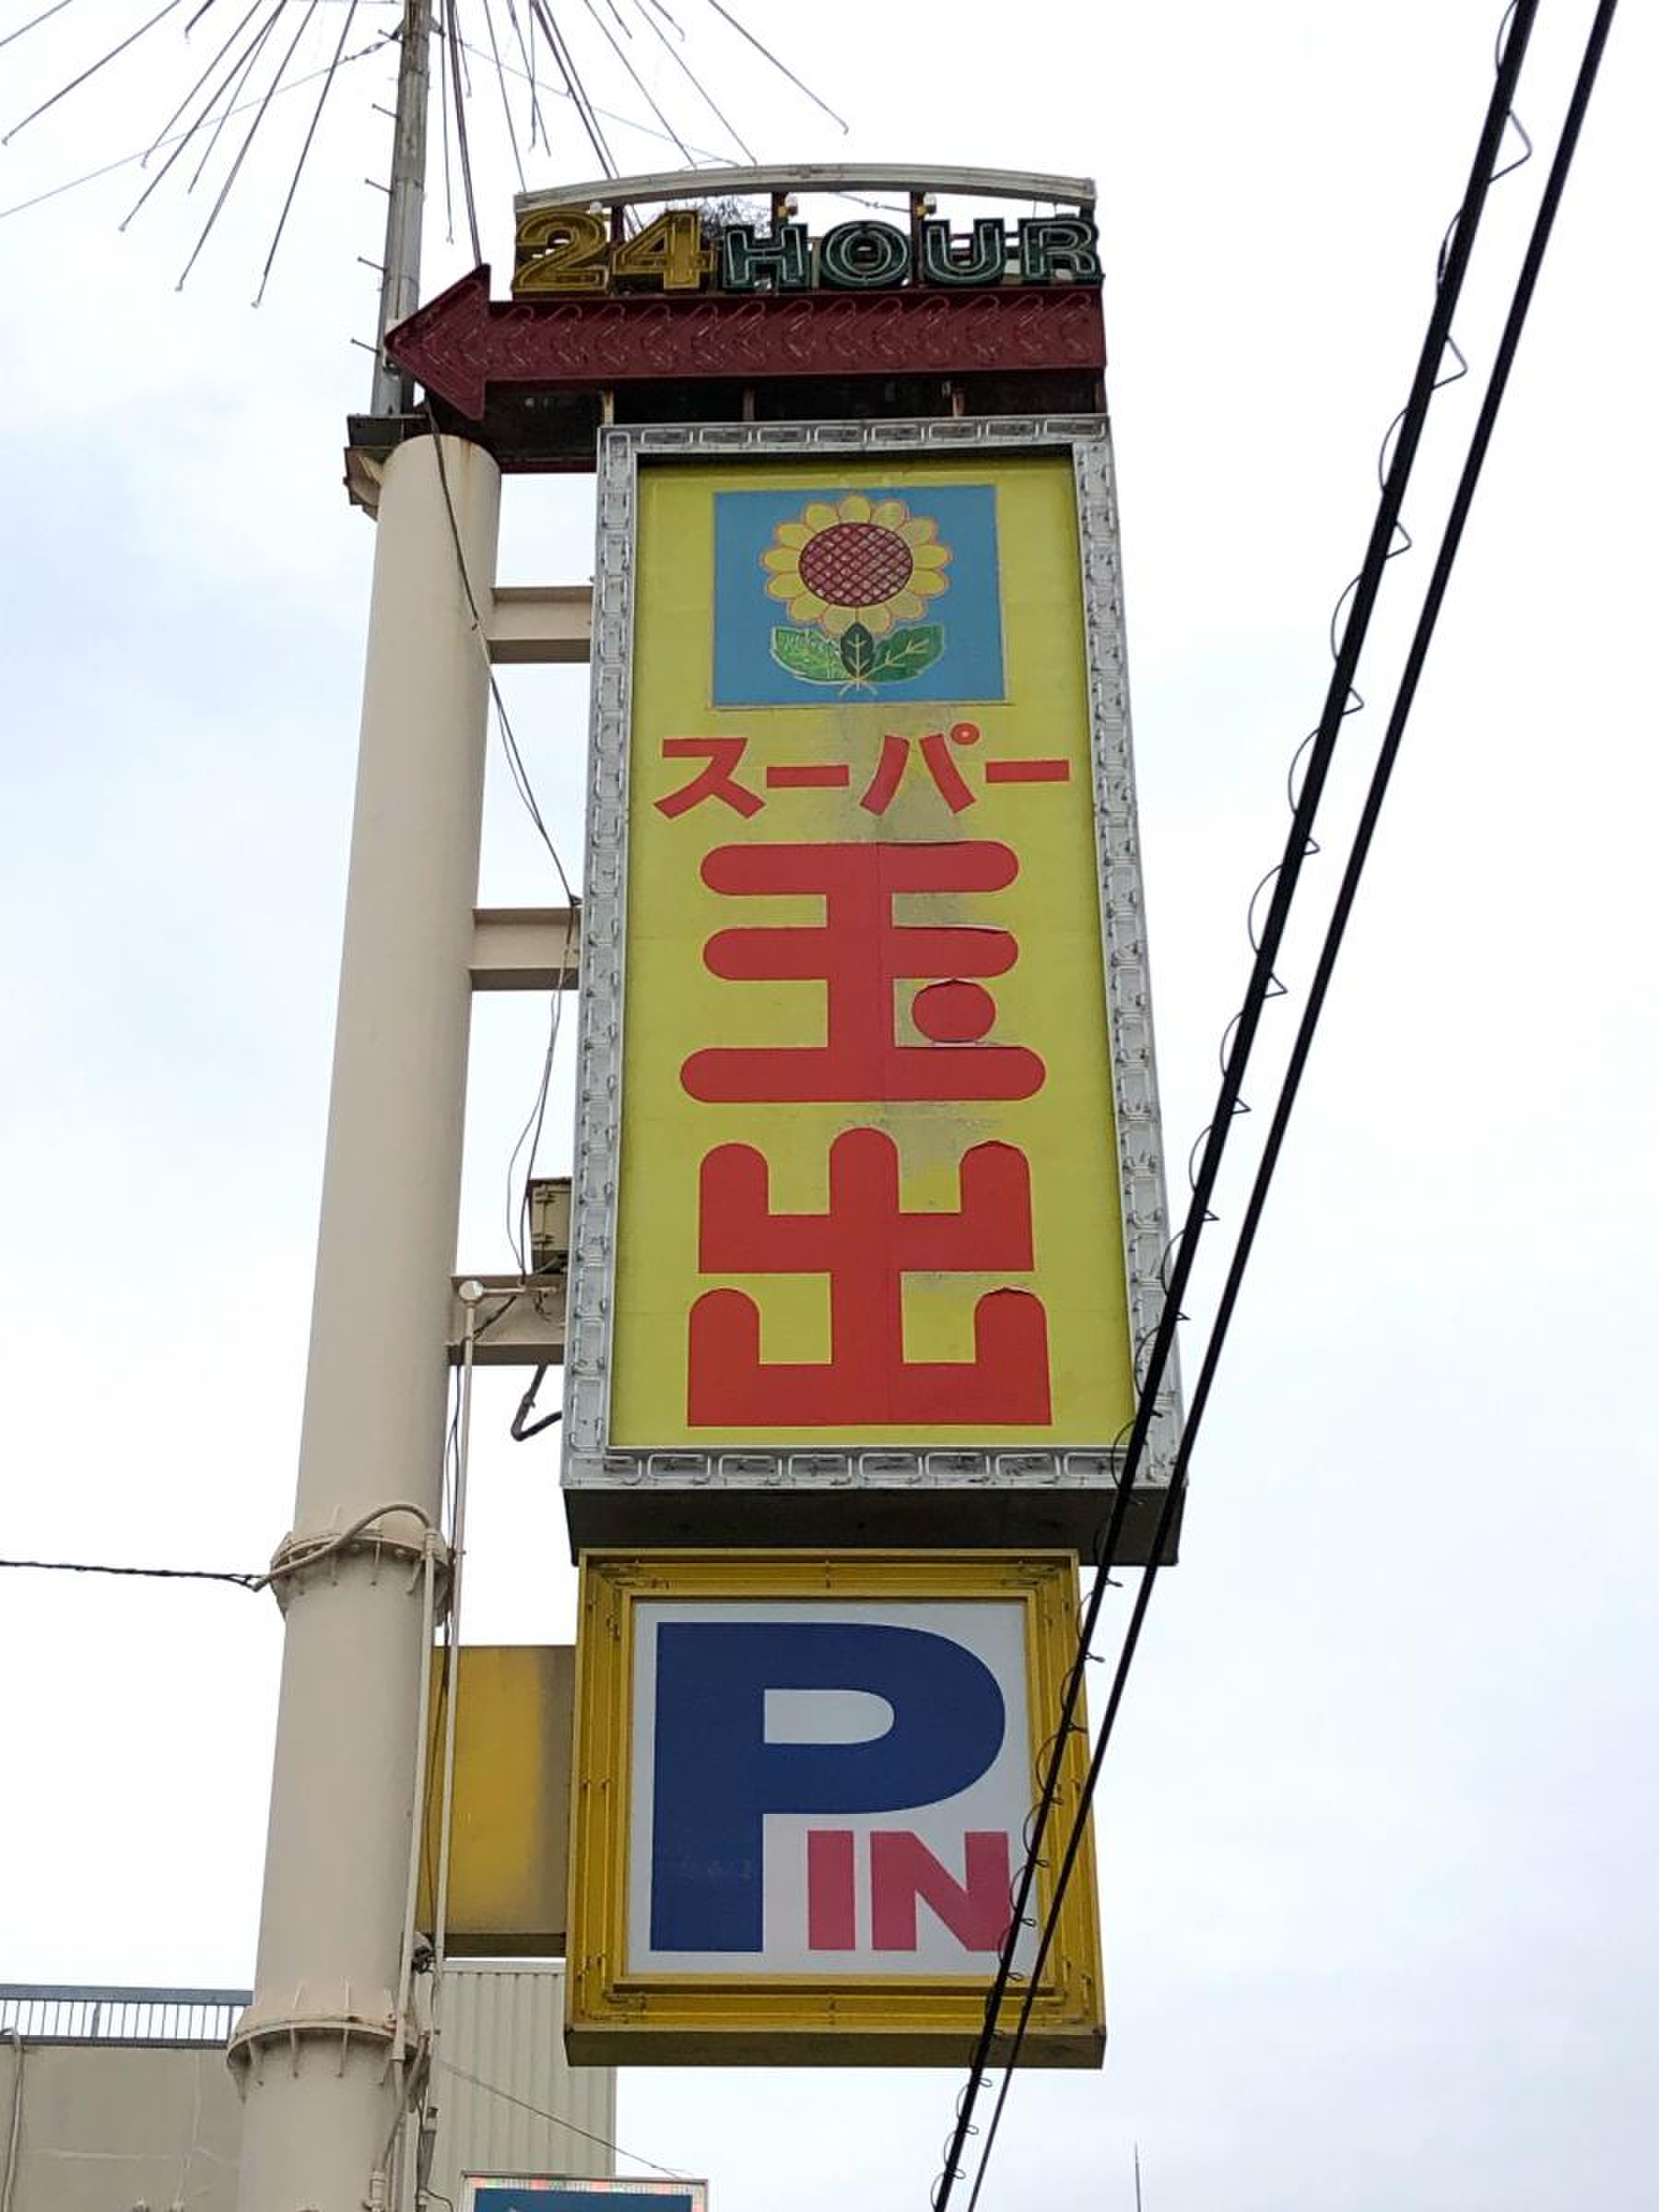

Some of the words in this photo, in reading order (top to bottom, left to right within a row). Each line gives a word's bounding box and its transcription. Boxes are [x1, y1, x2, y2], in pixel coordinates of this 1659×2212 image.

[512, 206, 716, 293] 24
[722, 218, 1101, 290] HOUR
[653, 723, 1070, 819] スーパー
[679, 840, 1053, 1428] 玉出
